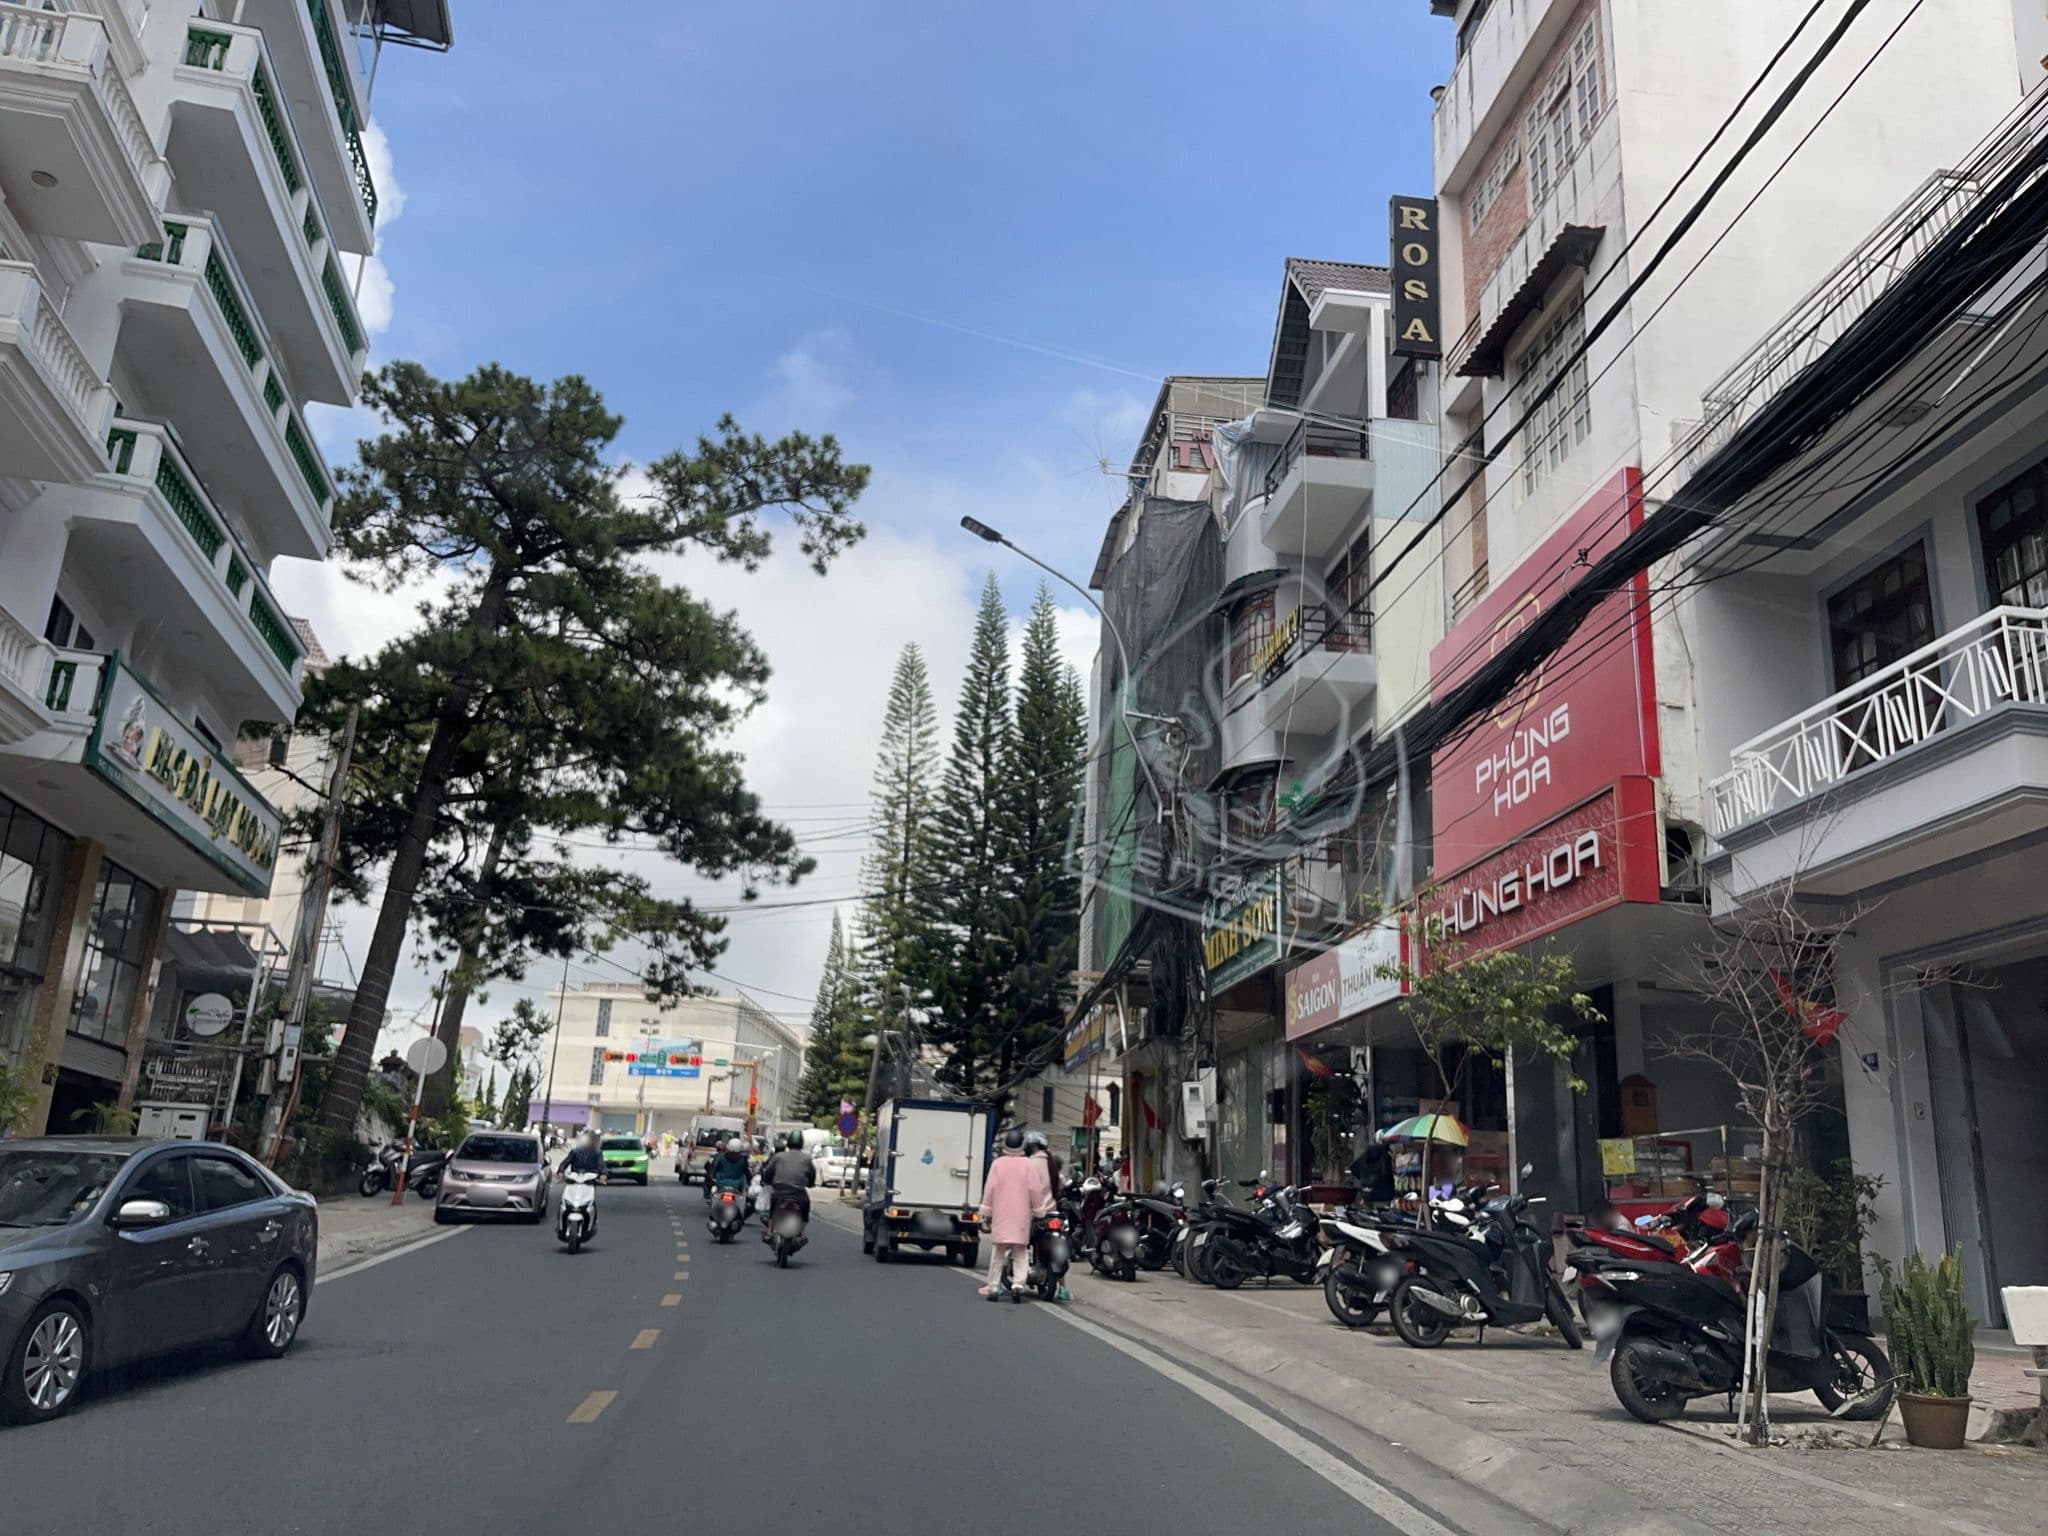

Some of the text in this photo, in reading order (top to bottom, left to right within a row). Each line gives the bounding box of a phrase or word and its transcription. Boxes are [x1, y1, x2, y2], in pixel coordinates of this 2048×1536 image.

[1399, 206, 1434, 343] ROSA
[1475, 703, 1570, 795] PHÙNG
[1494, 755, 1551, 817] HOA
[1526, 830, 1600, 900] HOA
[1297, 979, 1336, 1019] SAIGON
[1342, 966, 1373, 998] THUẬN
